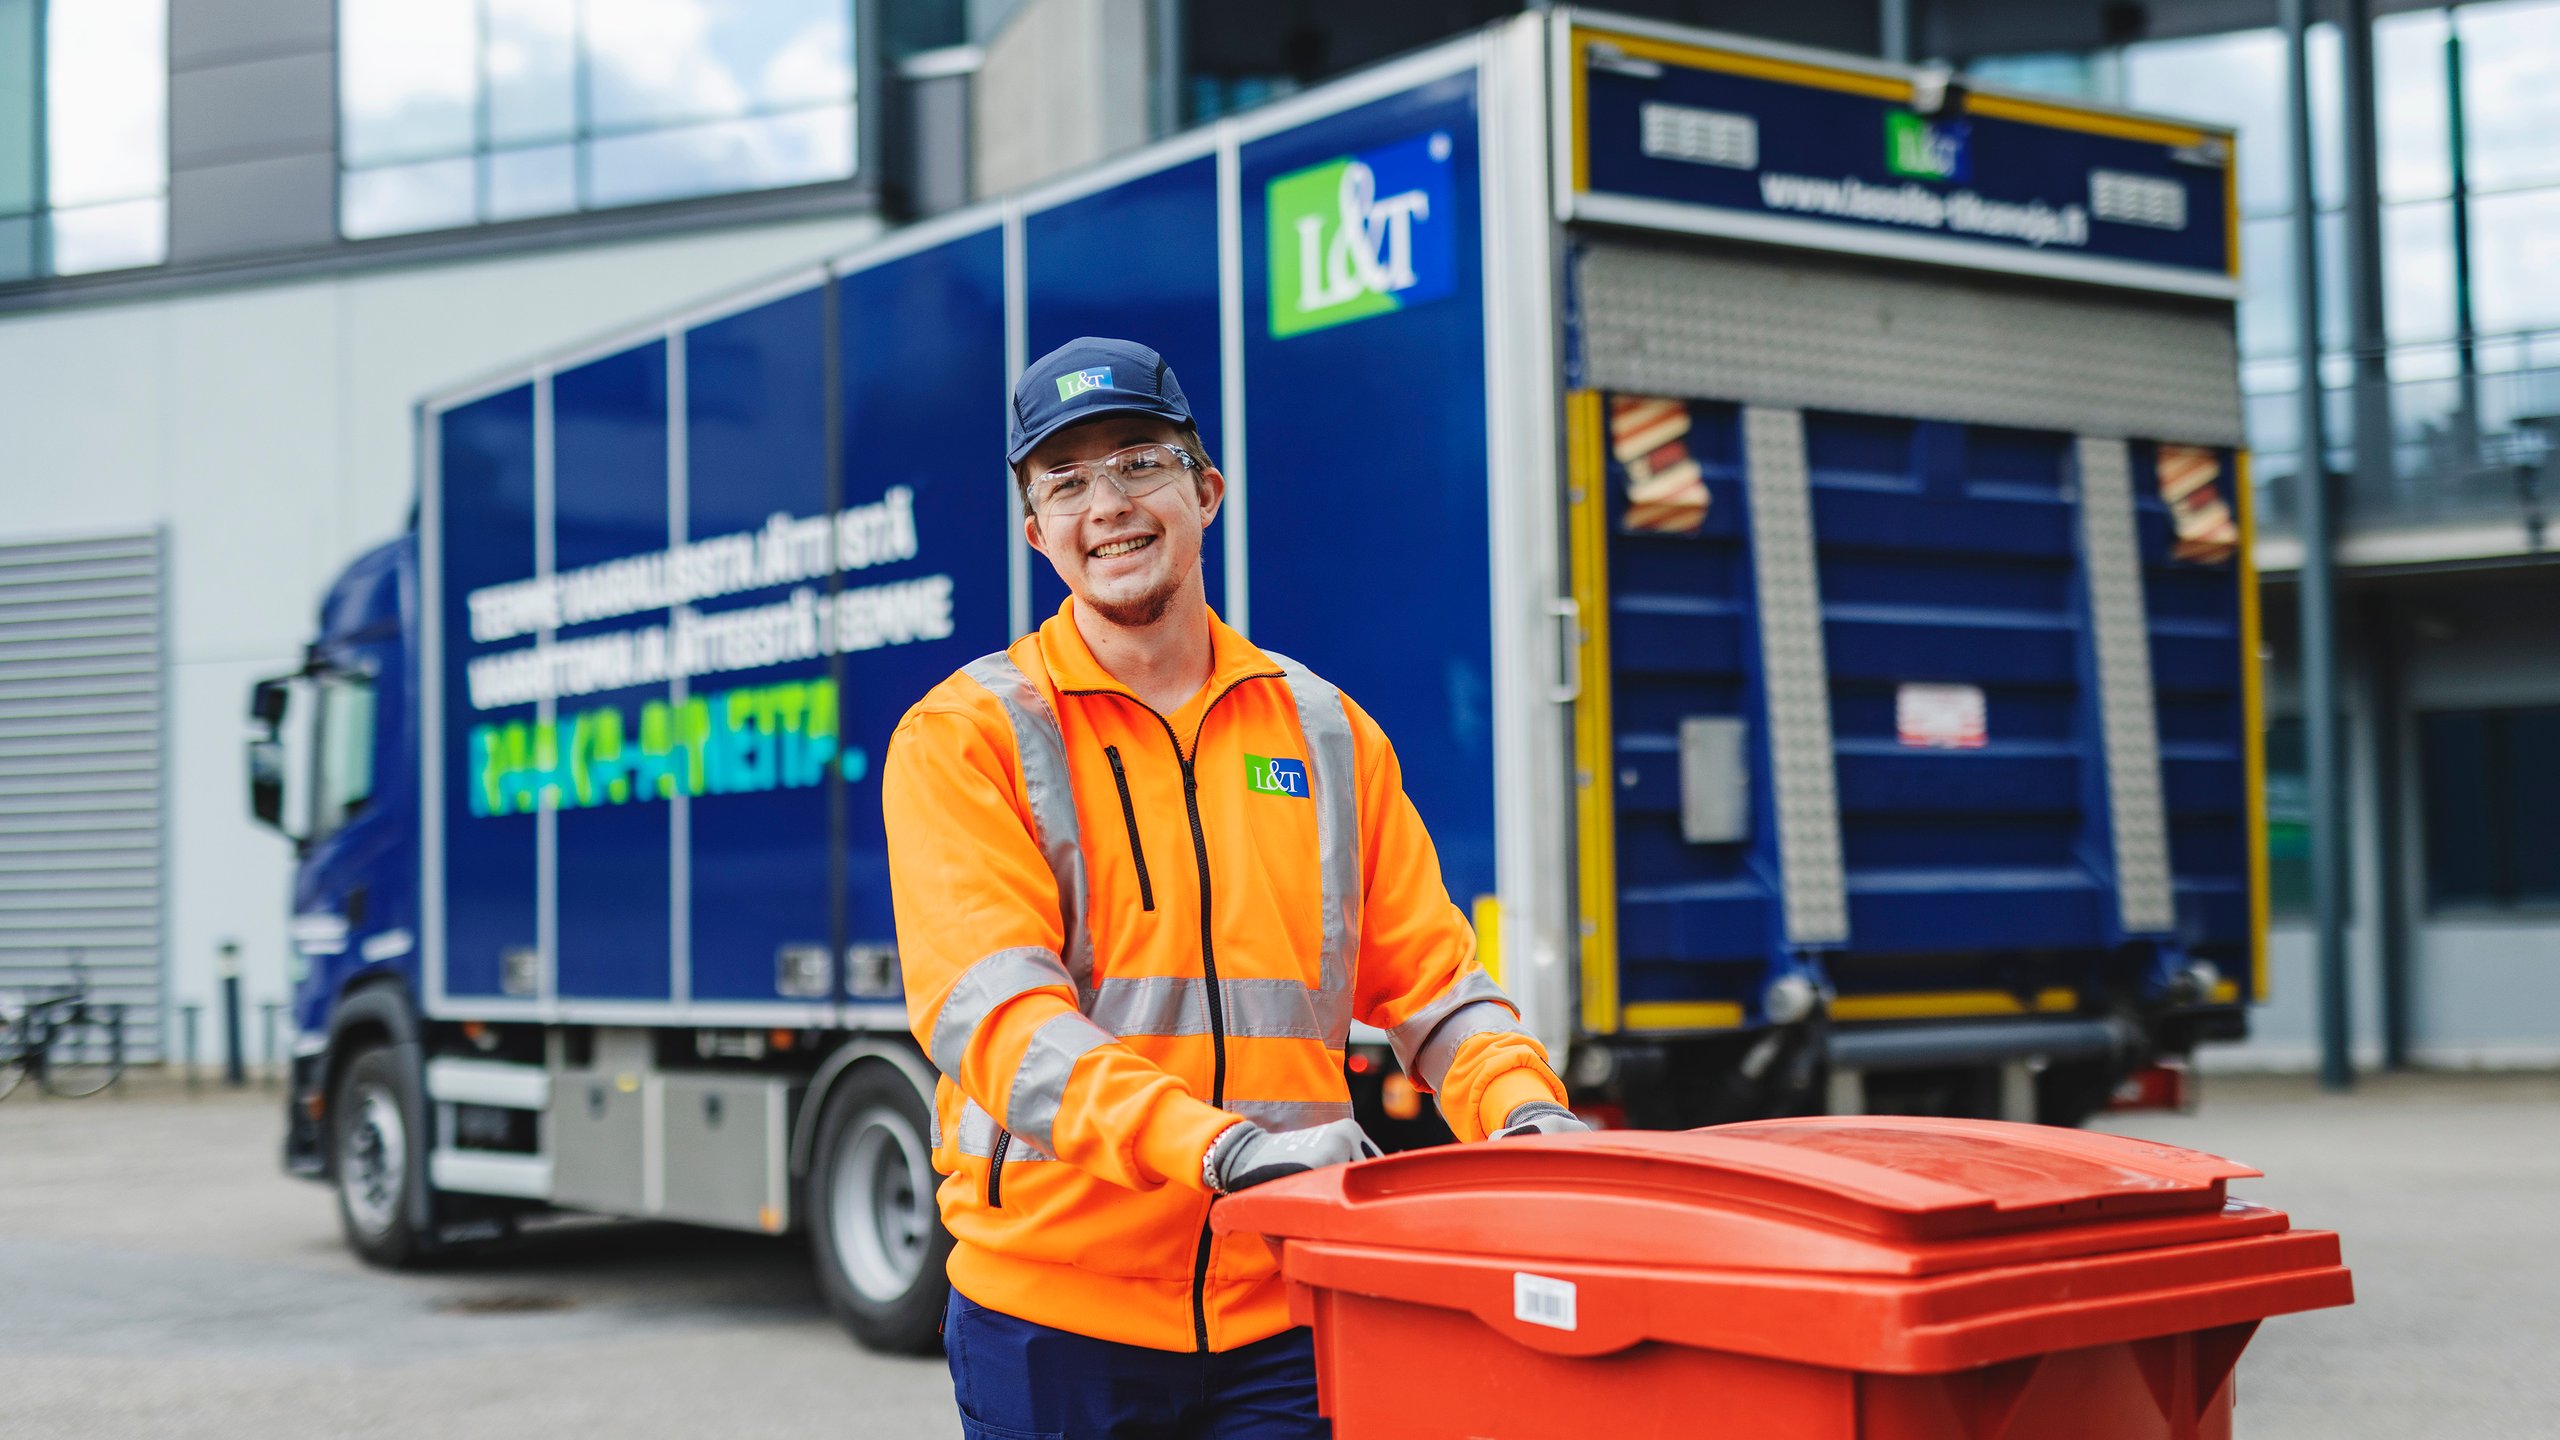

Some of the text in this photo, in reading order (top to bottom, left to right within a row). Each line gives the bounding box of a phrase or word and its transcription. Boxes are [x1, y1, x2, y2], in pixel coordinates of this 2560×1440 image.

[1295, 161, 1430, 313] L&T
[1067, 371, 1105, 397] L&T
[1254, 760, 1301, 793] L&T
